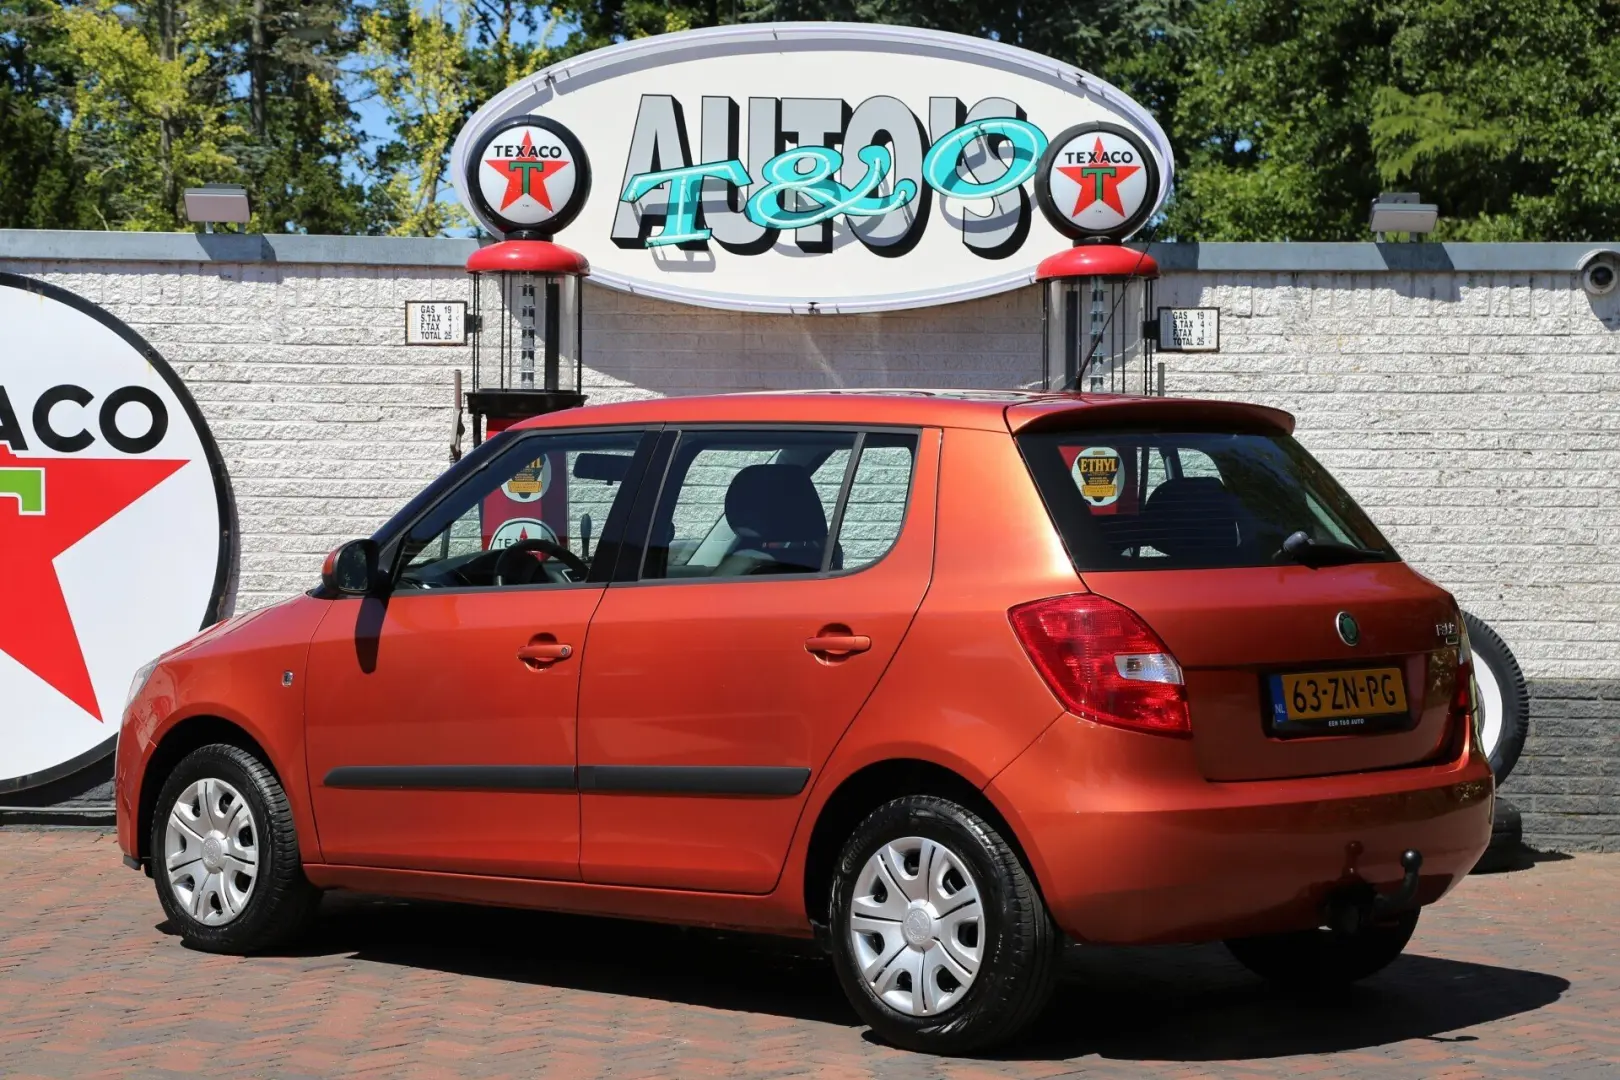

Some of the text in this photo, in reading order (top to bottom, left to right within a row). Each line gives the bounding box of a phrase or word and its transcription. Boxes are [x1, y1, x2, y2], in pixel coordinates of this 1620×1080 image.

[493, 145, 563, 159] TEXACO
[1064, 150, 1134, 164] TEXACO
[610, 93, 1032, 260] AUTO'S
[421, 305, 452, 314] GAS 19
[421, 314, 452, 322] S.TAX 4
[1173, 311, 1205, 320] GAS 19
[421, 322, 440, 331] F.TAX
[1173, 320, 1205, 329] S.TAX 4
[421, 331, 453, 340] TOTAL 25
[1173, 328, 1193, 337] F.TAX
[1173, 337, 1205, 346] TOTAL 25
[1081, 458, 1117, 472] ETHYL
[1293, 674, 1396, 713] 63-ZN-PG
[1274, 703, 1286, 714] NL
